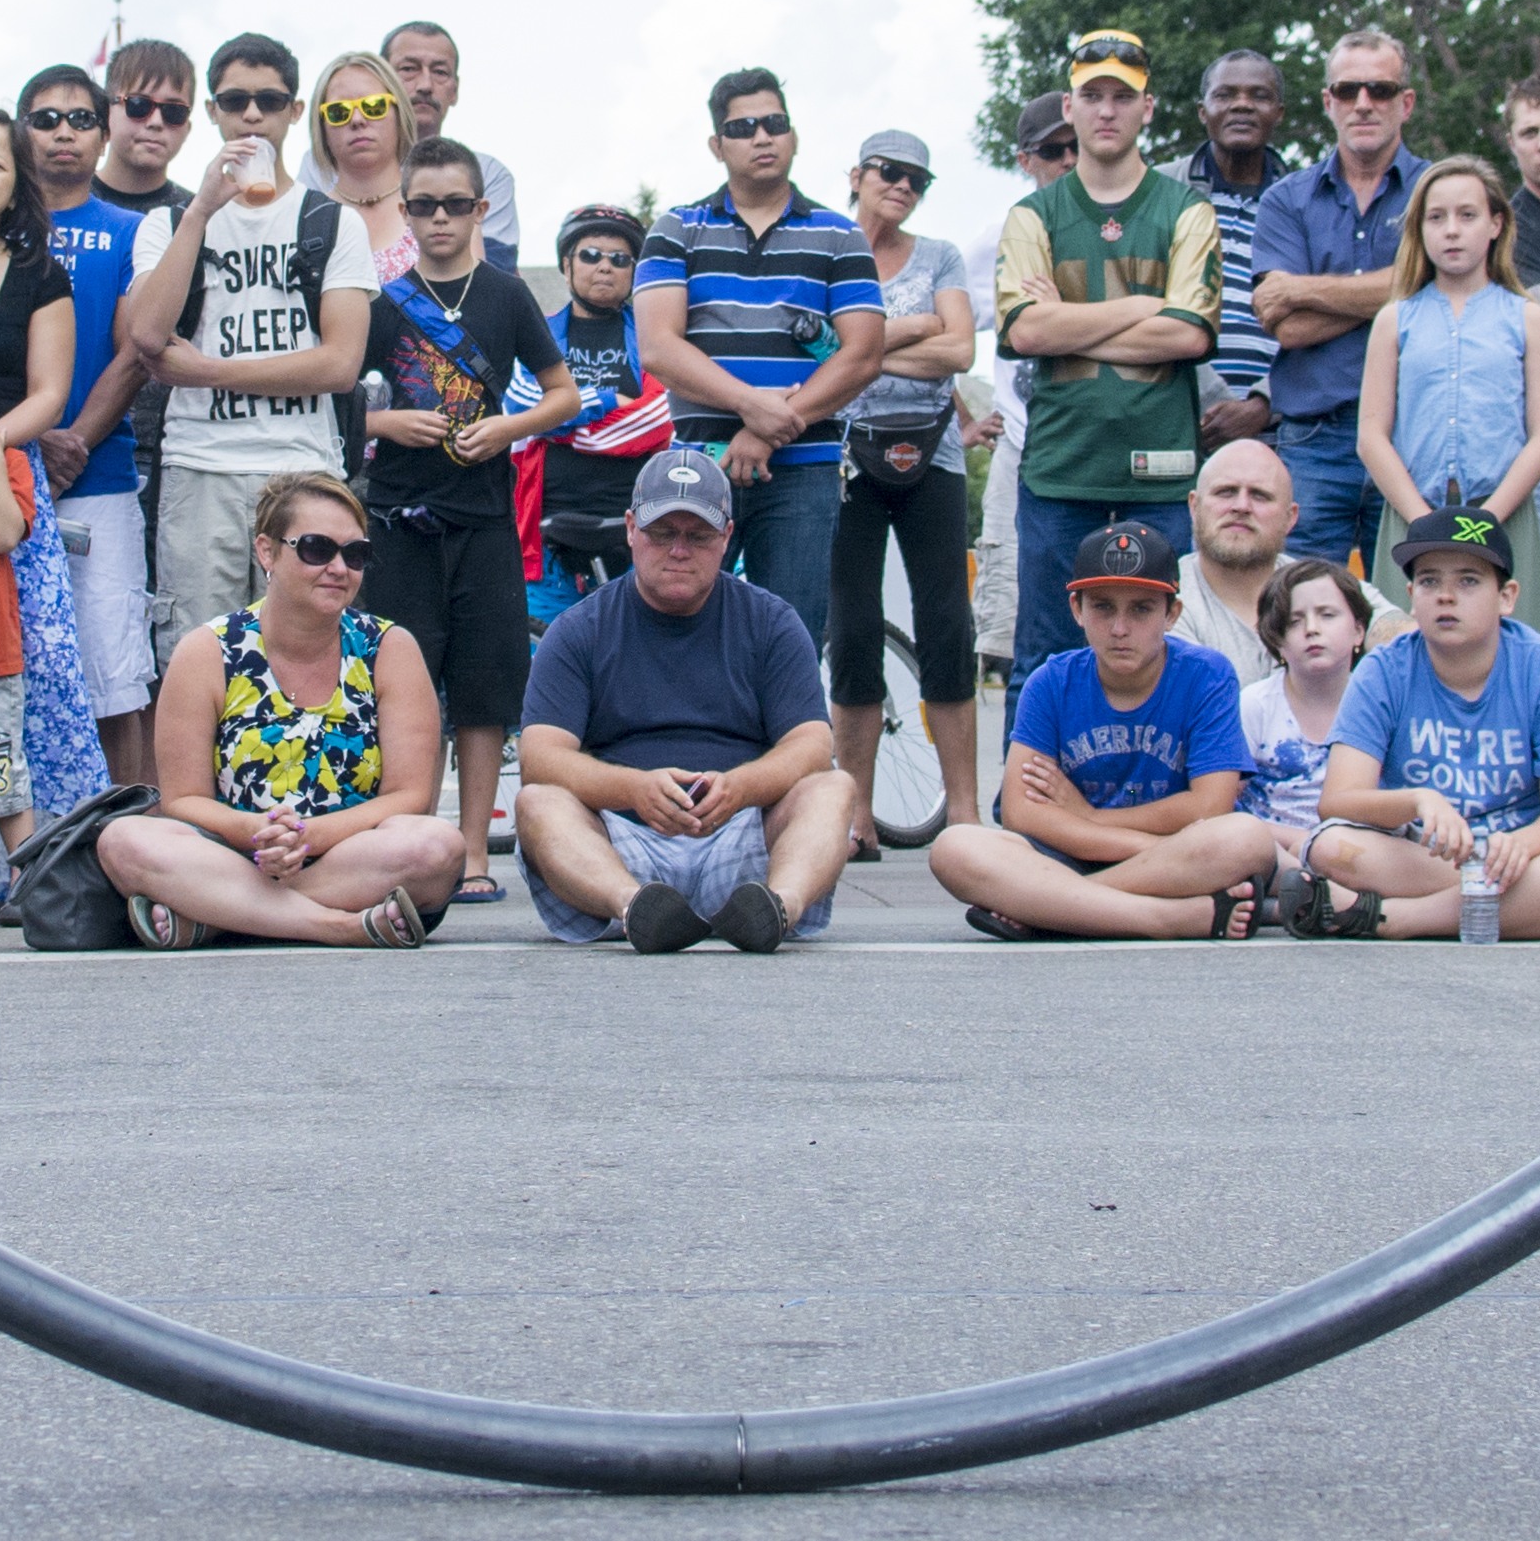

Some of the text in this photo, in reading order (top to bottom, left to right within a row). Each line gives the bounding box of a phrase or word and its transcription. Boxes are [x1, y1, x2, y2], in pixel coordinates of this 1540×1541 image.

[219, 307, 307, 358] SLEEP
[1060, 725, 1184, 773] AMERICAN
[1409, 718, 1526, 765] WE'RE
[1403, 758, 1526, 796] GONNA
